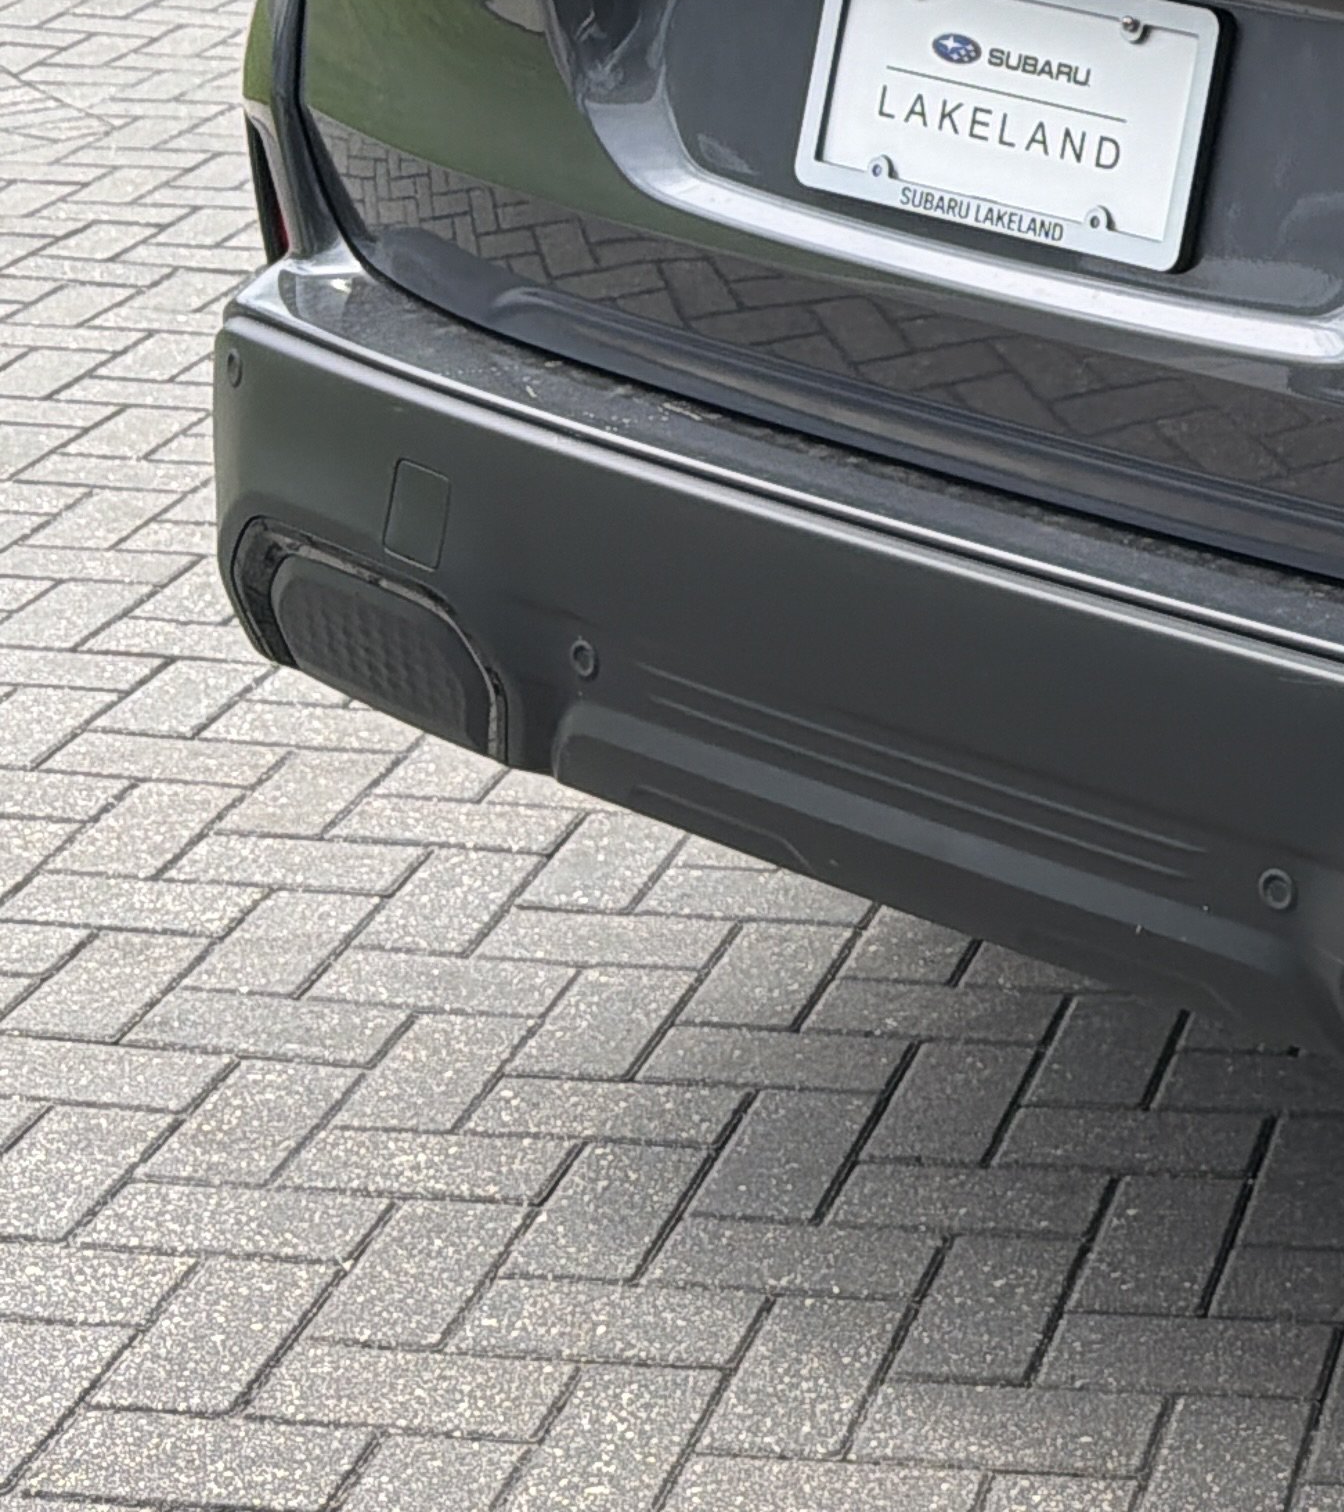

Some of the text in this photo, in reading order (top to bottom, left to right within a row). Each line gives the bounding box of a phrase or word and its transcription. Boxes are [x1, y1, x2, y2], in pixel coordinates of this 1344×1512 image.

[988, 48, 1091, 87] SUBARU
[878, 85, 1121, 170] LAKELAND
[899, 186, 1064, 241] SUBARU LAKELAND
